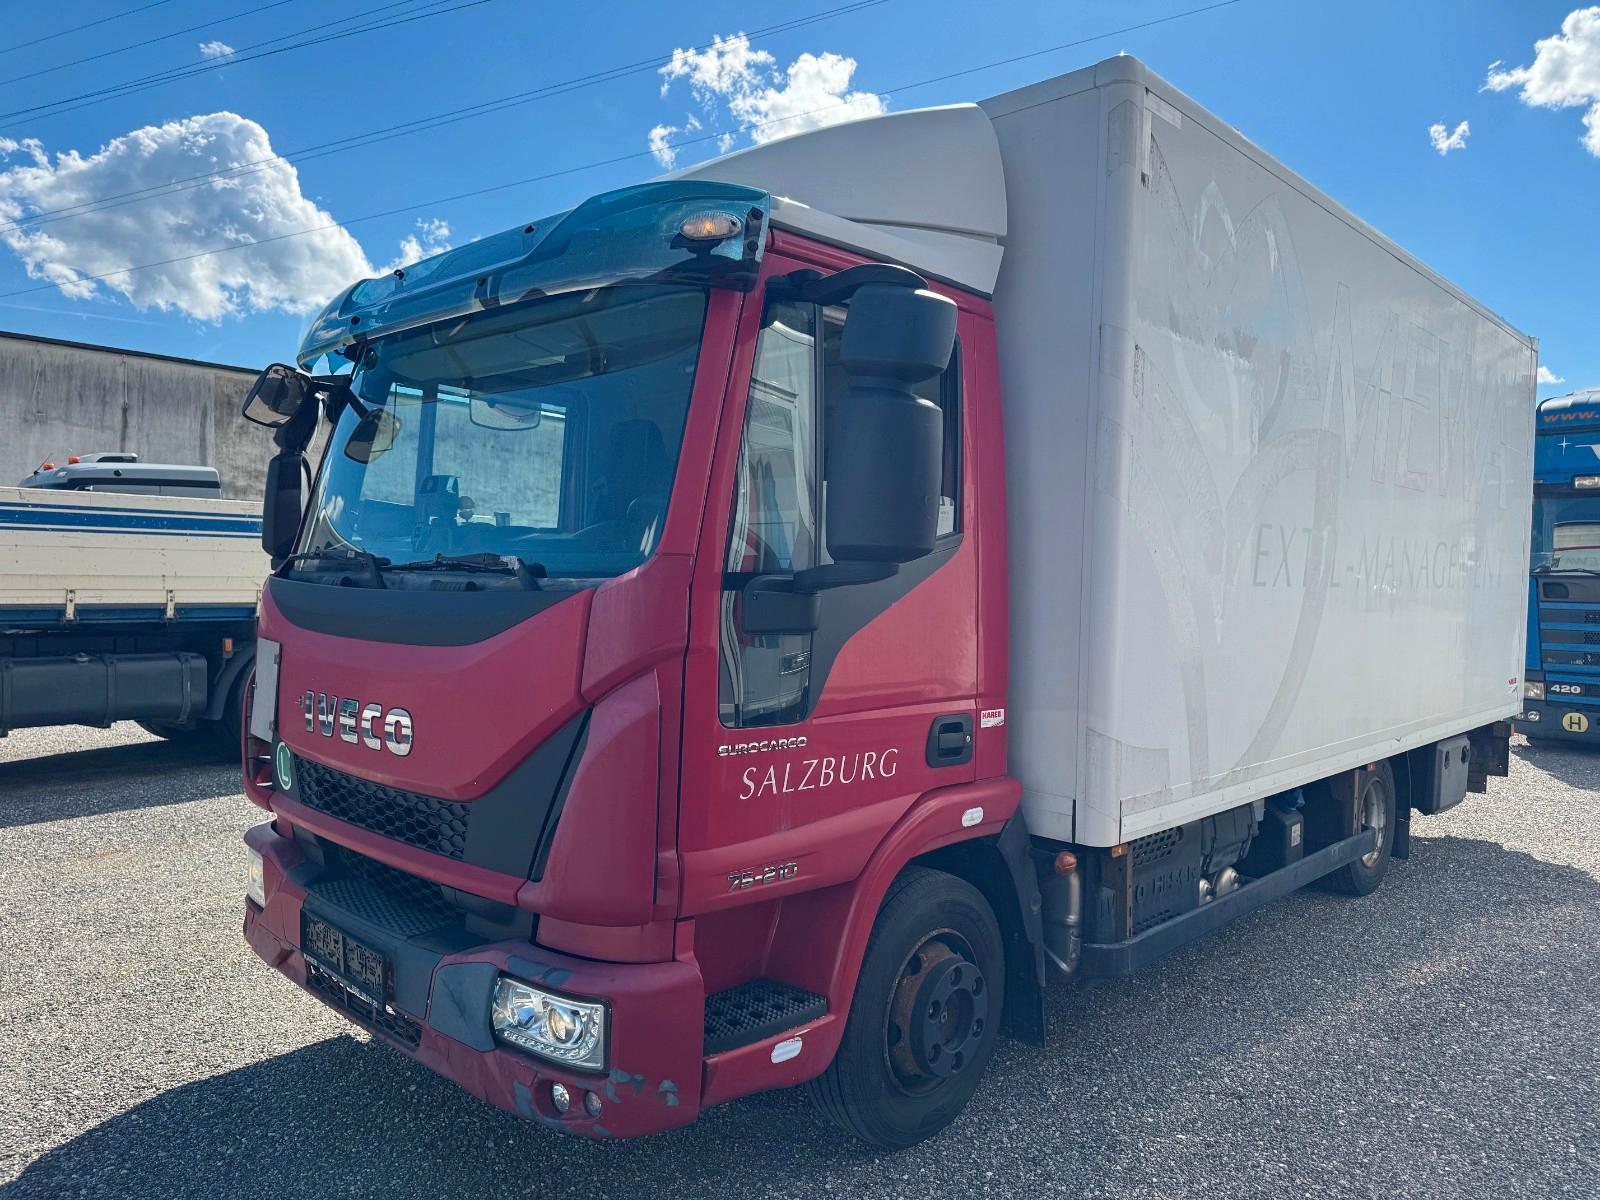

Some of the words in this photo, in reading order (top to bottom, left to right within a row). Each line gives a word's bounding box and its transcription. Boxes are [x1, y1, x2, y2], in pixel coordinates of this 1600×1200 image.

[1551, 684, 1581, 694] 420
[305, 690, 414, 756] IVECO
[1569, 715, 1582, 731] H
[718, 736, 807, 757] EUROCARGO
[280, 751, 289, 781] L
[739, 748, 899, 800] SALZBURG
[727, 862, 798, 893] 75-210
